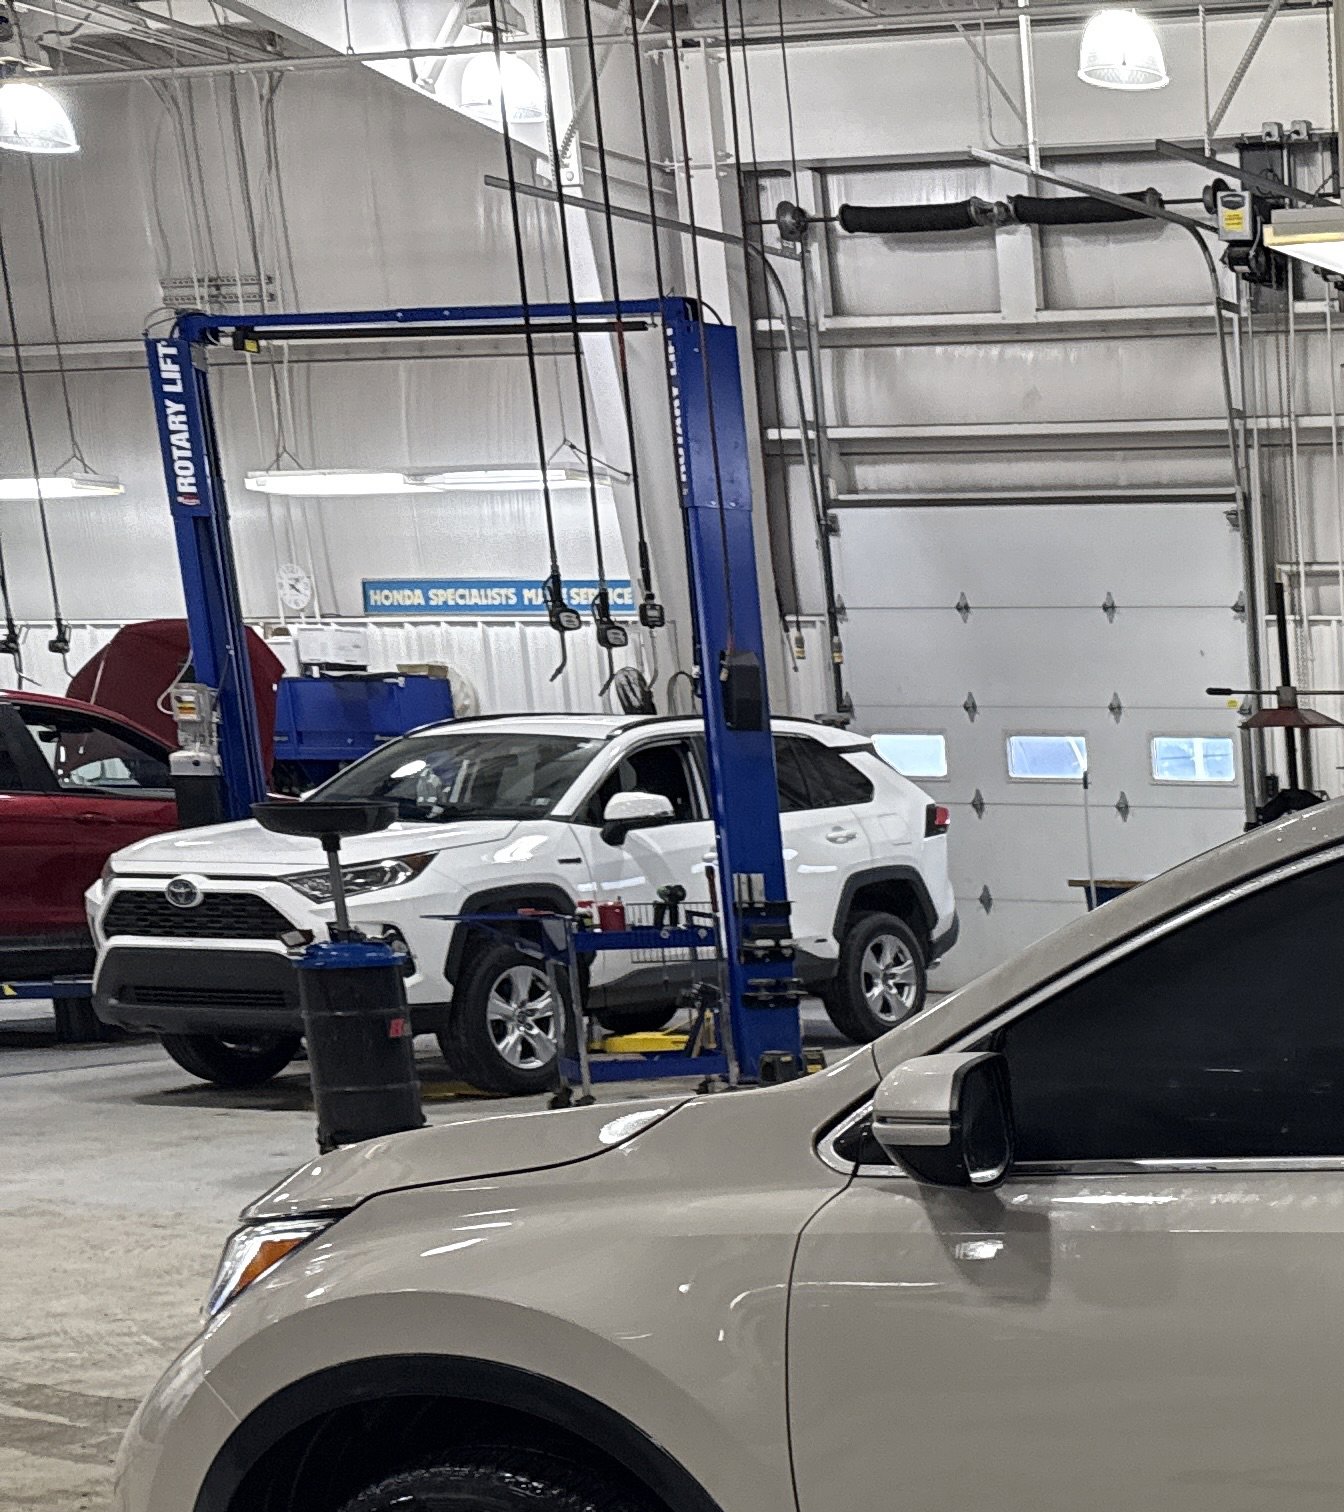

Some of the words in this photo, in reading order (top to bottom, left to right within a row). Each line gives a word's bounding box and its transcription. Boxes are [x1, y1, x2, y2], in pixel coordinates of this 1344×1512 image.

[156, 341, 183, 392] LIFT
[164, 399, 198, 493] ROTARY
[369, 589, 426, 607] HONDA
[428, 587, 518, 606] SPECIALISTS
